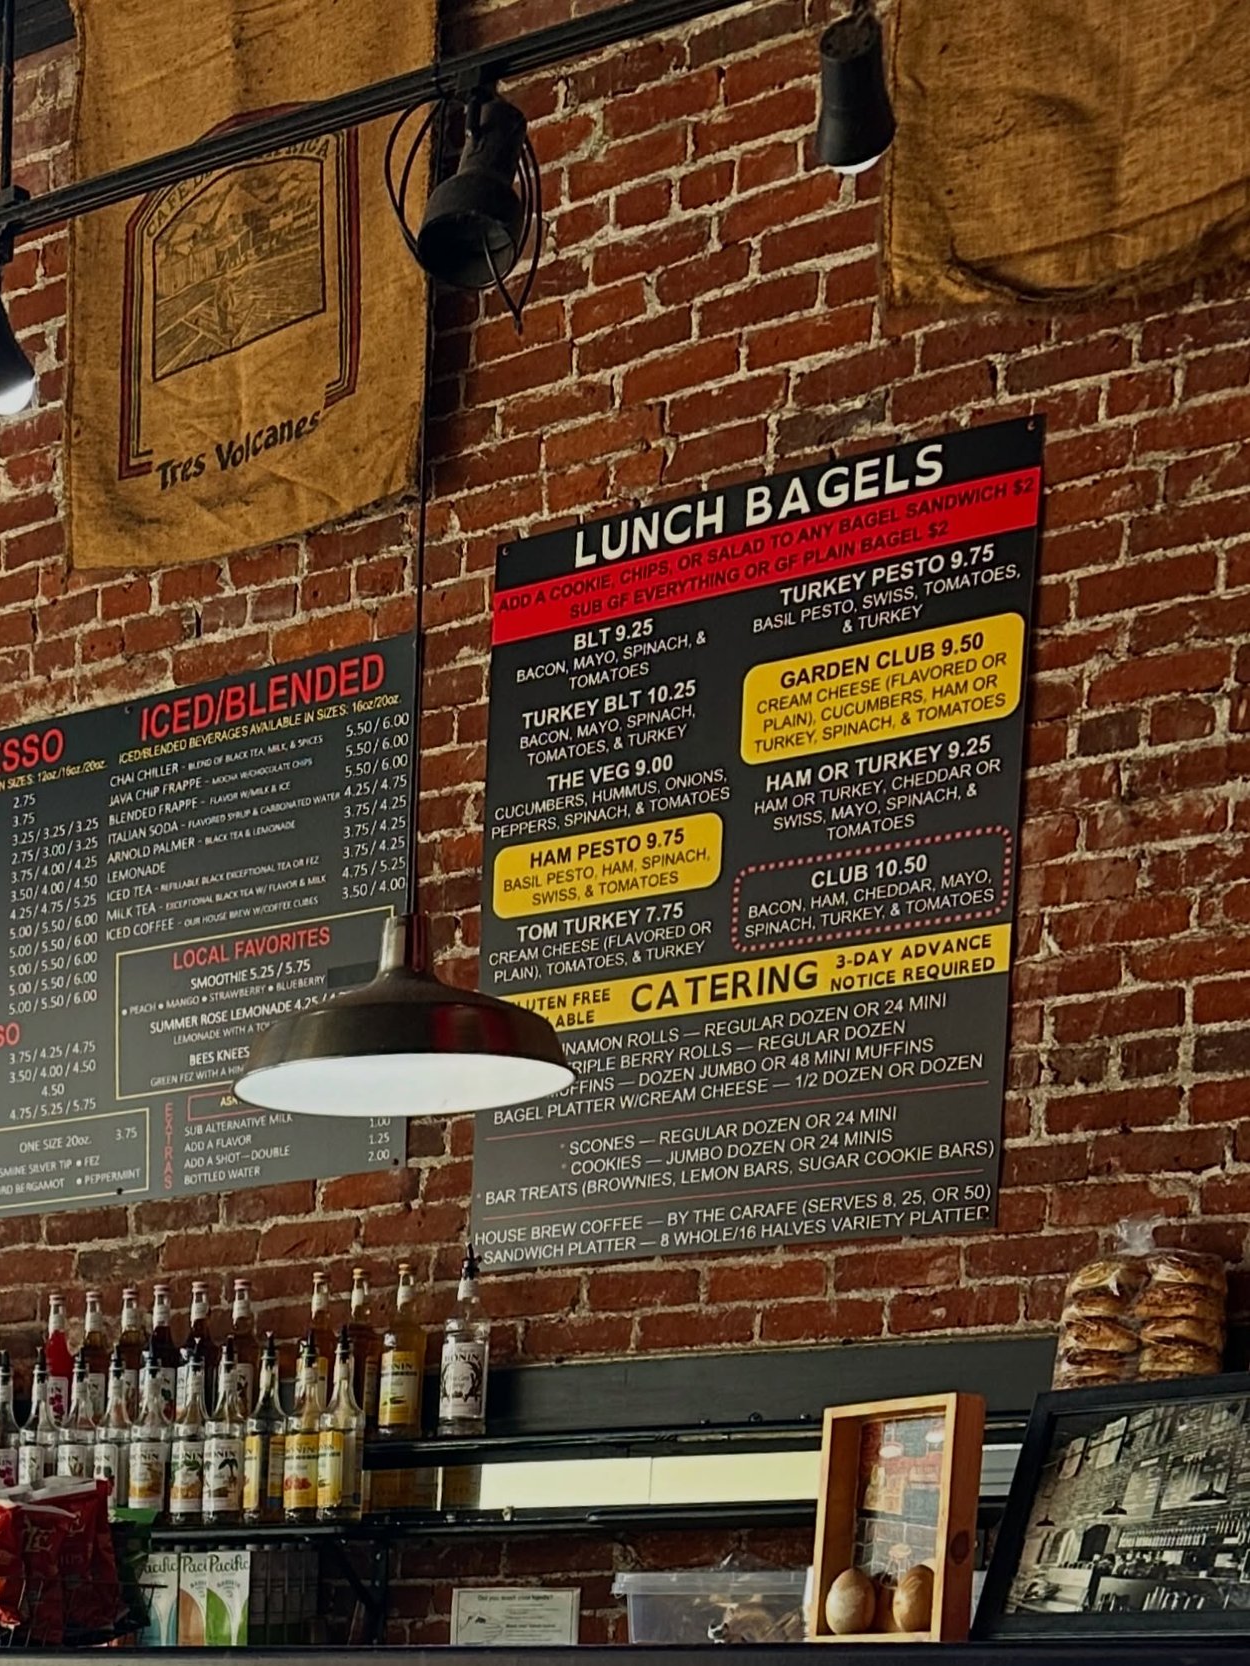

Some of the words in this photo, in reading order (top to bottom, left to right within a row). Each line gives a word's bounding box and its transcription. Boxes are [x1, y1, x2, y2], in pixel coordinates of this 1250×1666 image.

[156, 453, 206, 490] Tres
[215, 410, 321, 471] Volcanes
[574, 494, 725, 569] LUNCH
[744, 442, 945, 528] BAGELS
[778, 570, 866, 607] TURKEY
[871, 553, 946, 587] PESTO
[949, 542, 995, 571] 9.75
[573, 626, 612, 652] BLT
[614, 617, 654, 643] 9.25
[752, 610, 797, 634] BASIL
[779, 654, 870, 691] GARDEN
[874, 641, 936, 671] CLUB
[940, 631, 985, 658] 9.50
[140, 651, 385, 743] ICED/BLENDED
[755, 690, 813, 716] CREAM
[815, 676, 882, 704] CHEESE
[980, 651, 1007, 671] OR
[520, 698, 600, 731] TURKEY
[603, 689, 642, 714] BLT
[646, 679, 696, 706] 10.25
[109, 771, 135, 789] CHAI
[135, 761, 179, 783] CHILLER
[765, 767, 812, 793] HAM
[816, 760, 850, 784] OR
[853, 743, 943, 777] TURKEY
[946, 734, 992, 760] 9.25
[11, 811, 35, 829] 3.75
[107, 826, 147, 846] ITALIAN
[146, 819, 179, 839] SODA
[105, 844, 151, 866] ARNOLD
[152, 835, 195, 856] PALMER
[529, 846, 572, 870] HAM
[576, 834, 642, 862] PESTO
[645, 826, 685, 850] 9.75
[106, 860, 166, 885] LEMONADE
[810, 863, 869, 890] CLUB
[873, 853, 928, 879] 10.50
[172, 942, 231, 971] LOCAL
[233, 924, 331, 961] FAVORITES
[835, 947, 893, 970] 3-DAY
[899, 933, 992, 961] ADVANCE
[629, 959, 819, 1014] CATERING
[829, 969, 897, 993] NOTICE
[902, 955, 996, 984] REQUIRED
[510, 993, 567, 1015] UTEN
[572, 988, 610, 1006] FREE
[40, 1082, 65, 1099] 4.50
[183, 1169, 226, 1187] BOTTLED
[226, 1165, 261, 1181] WATER
[367, 1148, 392, 1164] 2.00
[484, 1189, 516, 1205] BAR
[518, 1182, 578, 1201] TREATS
[680, 1164, 739, 1184] LEMON
[797, 1152, 860, 1173] SUGAR
[862, 1145, 934, 1167] COOKIE
[144, 1556, 178, 1574] acific
[208, 1554, 250, 1574] Pacific
